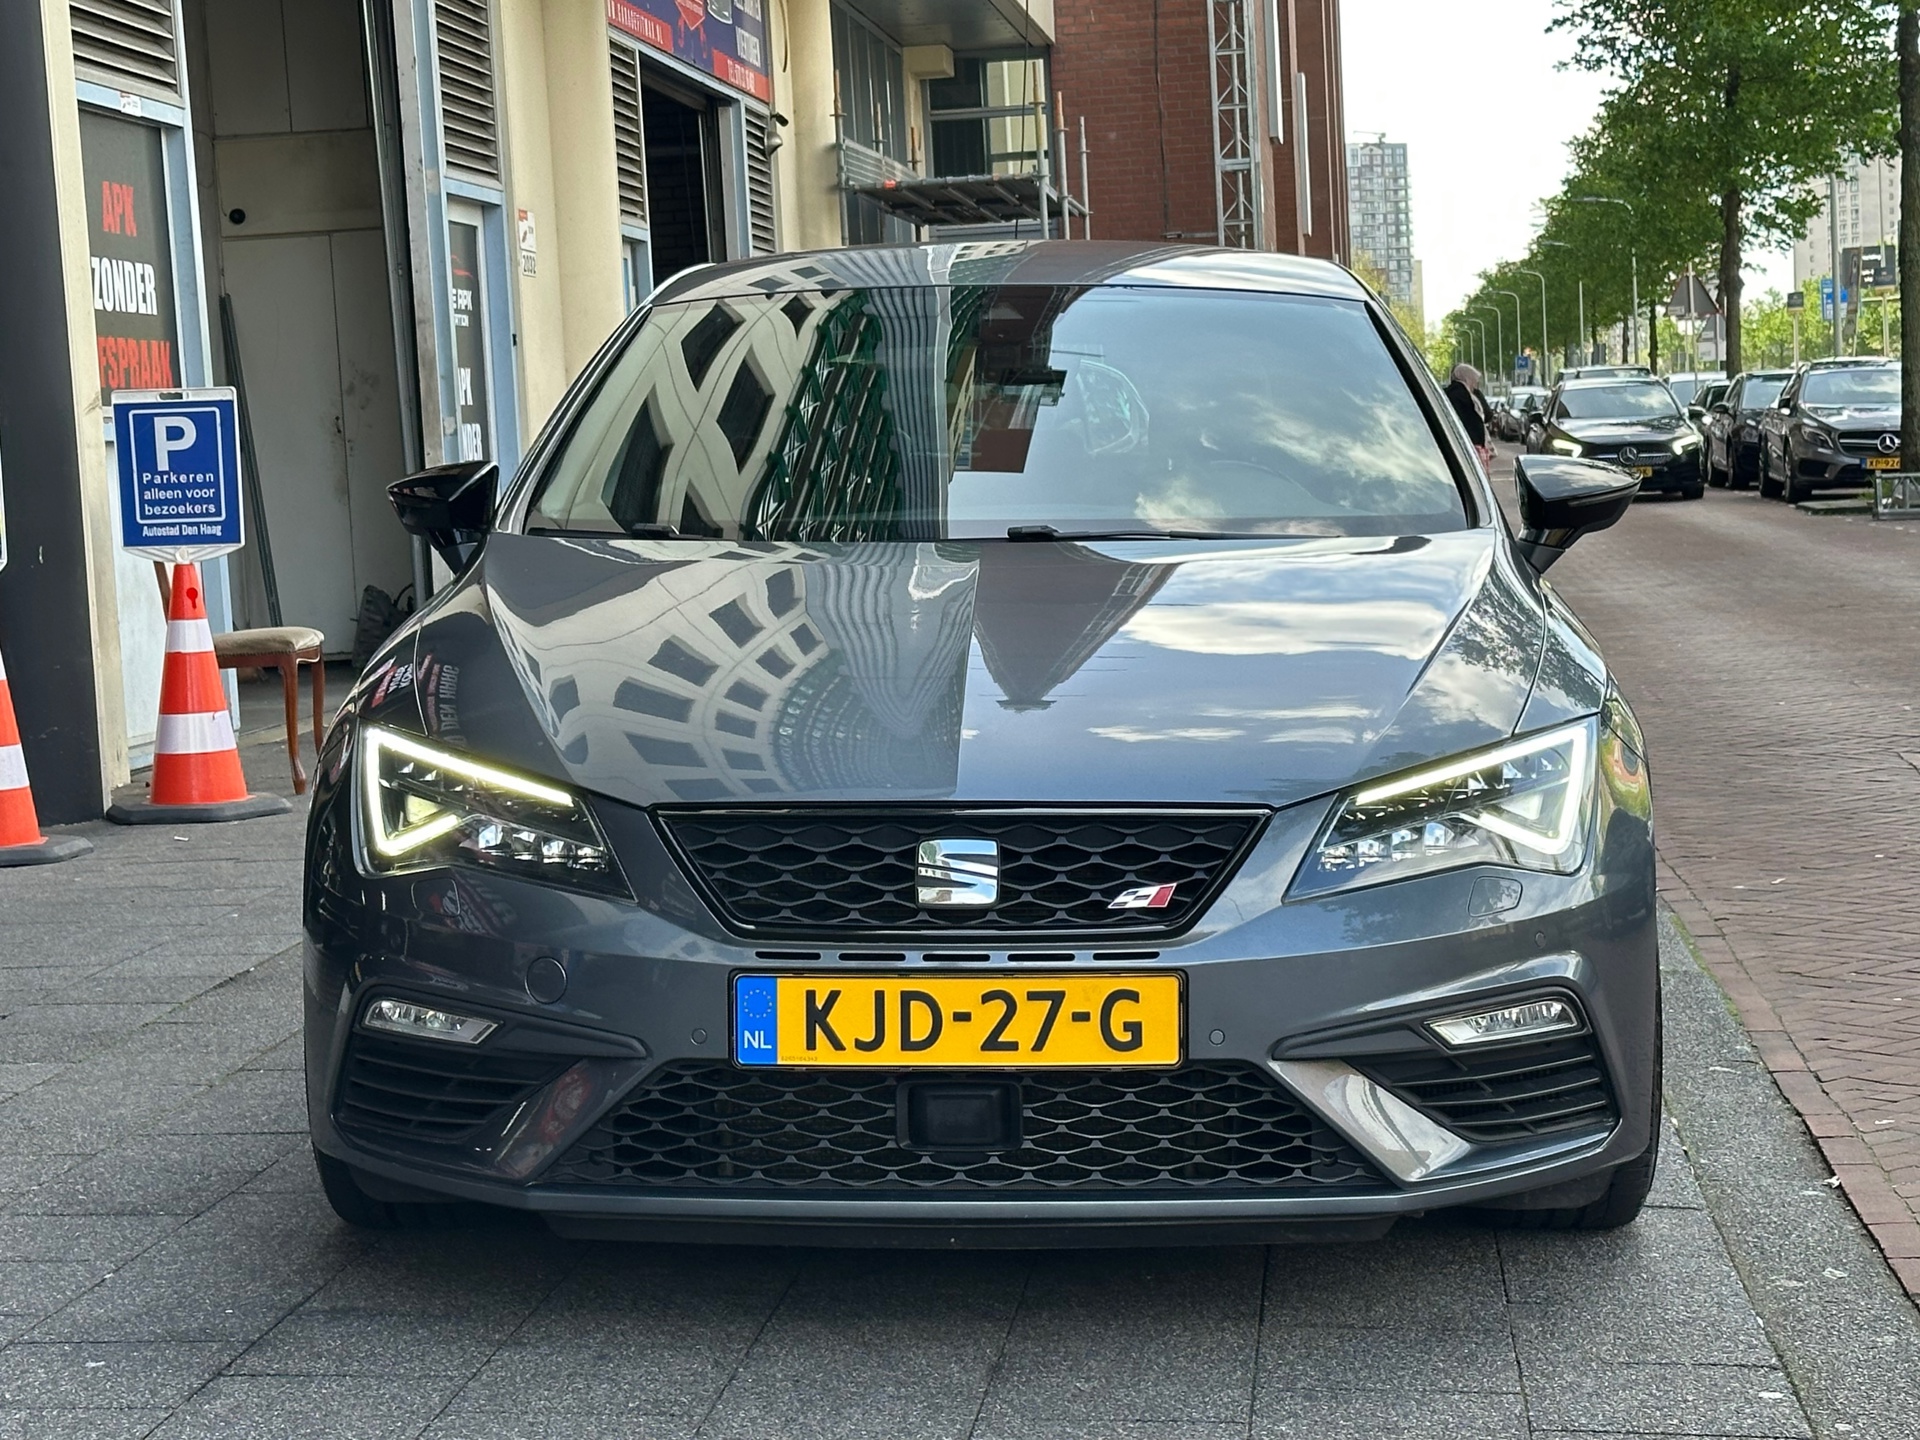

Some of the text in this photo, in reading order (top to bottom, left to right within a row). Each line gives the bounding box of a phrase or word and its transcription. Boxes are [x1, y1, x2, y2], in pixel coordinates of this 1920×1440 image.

[102, 180, 137, 237] APK
[90, 256, 158, 315] ZONDER
[97, 336, 174, 389] FSPRAAK
[457, 367, 473, 406] PK
[153, 416, 197, 471] P
[461, 423, 483, 461] NDER
[142, 470, 215, 484] Parkeren
[143, 488, 216, 500] alleen voor
[144, 502, 216, 516] bezoekers
[142, 523, 222, 537] Autostad Den Haag
[743, 1030, 772, 1049] NL
[804, 989, 1143, 1052] KJD-27-G
